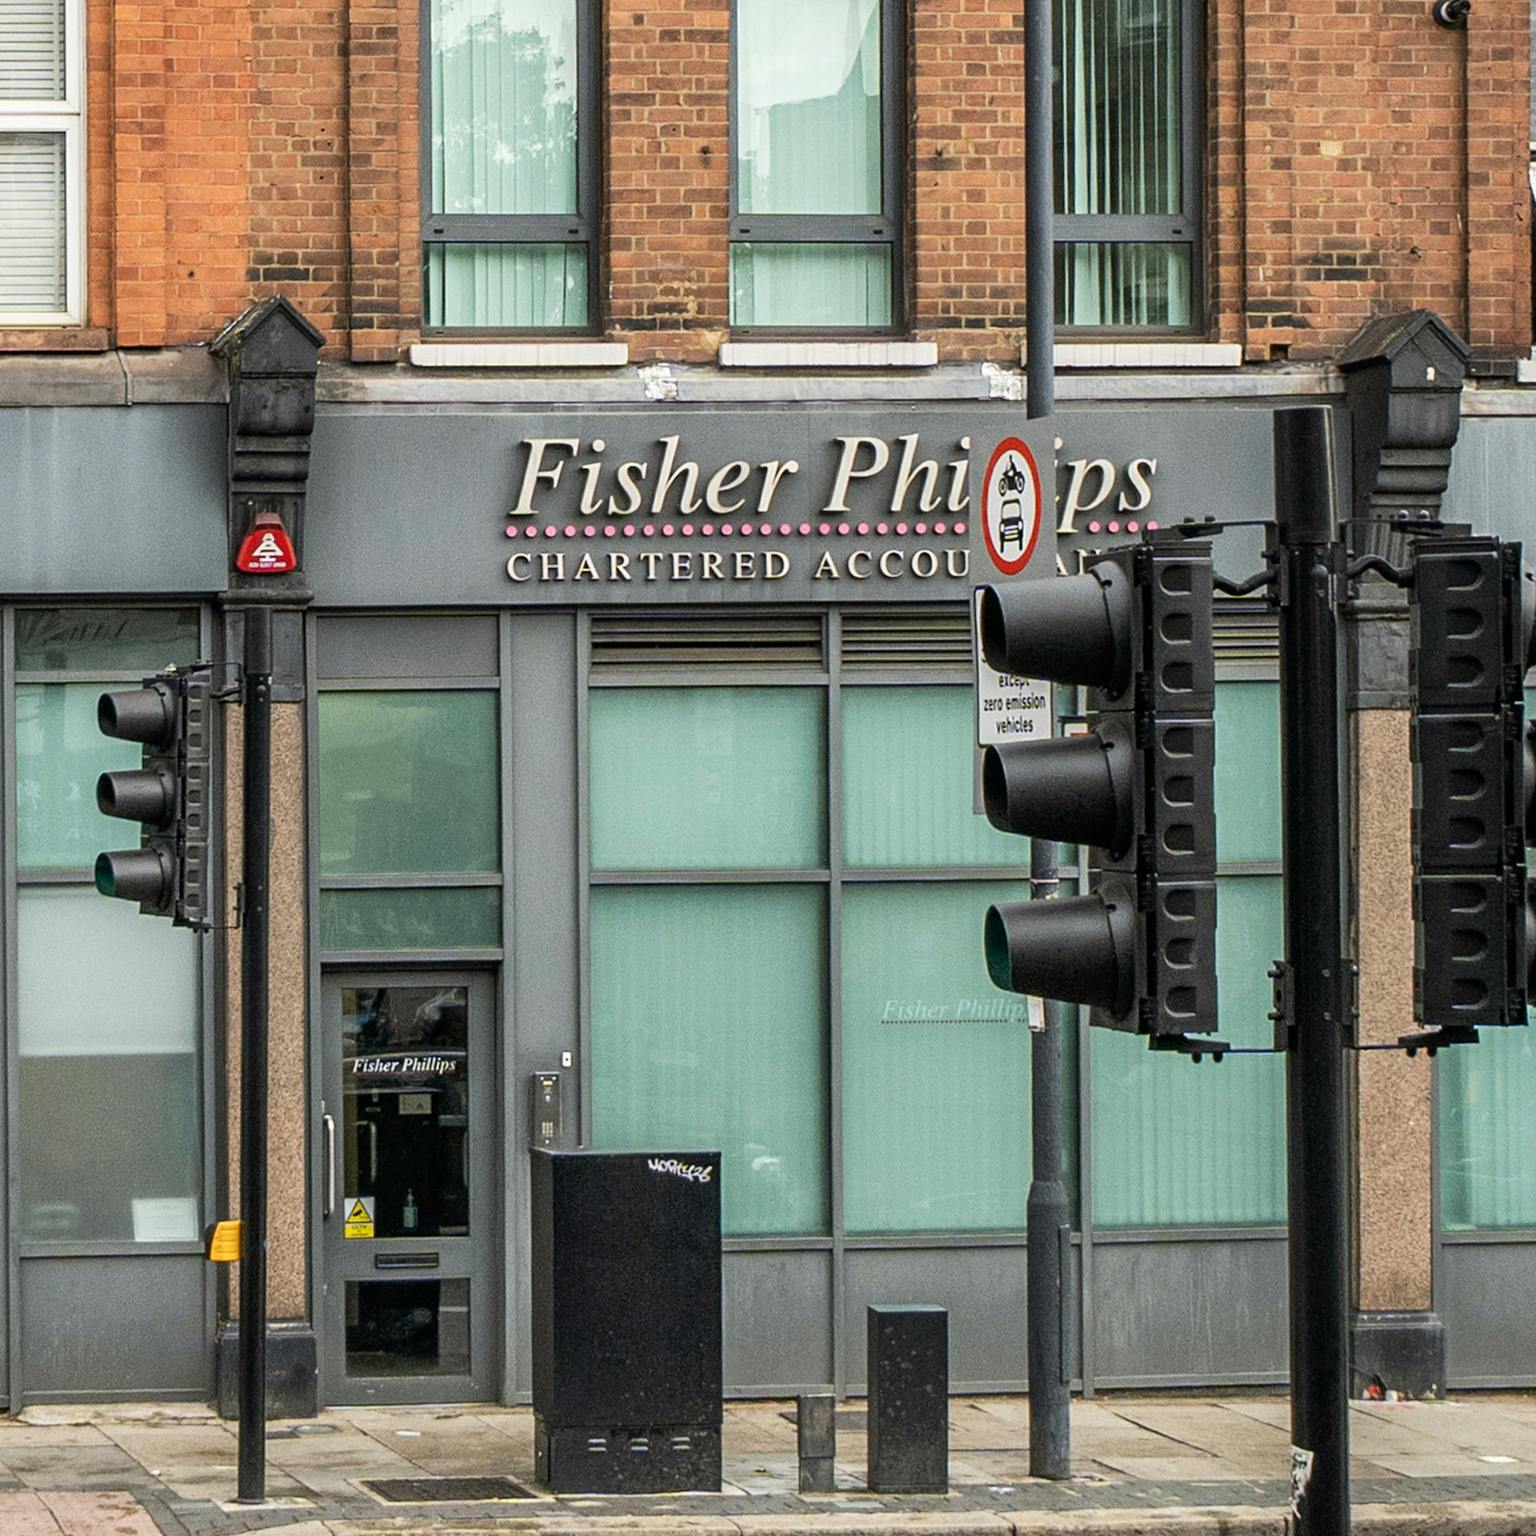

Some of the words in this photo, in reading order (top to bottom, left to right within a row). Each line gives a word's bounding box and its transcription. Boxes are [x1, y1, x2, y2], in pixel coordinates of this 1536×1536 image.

[508, 434, 799, 517] Fisher
[821, 433, 1158, 534] Phips
[506, 551, 792, 583] CHARTERED
[983, 698, 1003, 712] zero
[1005, 693, 1046, 711] emission
[995, 715, 1034, 734] vehicles
[882, 999, 951, 1020] Fisher
[955, 997, 1026, 1023] Phillip
[352, 1058, 400, 1074] Fisher
[402, 1056, 457, 1075] Phillips
